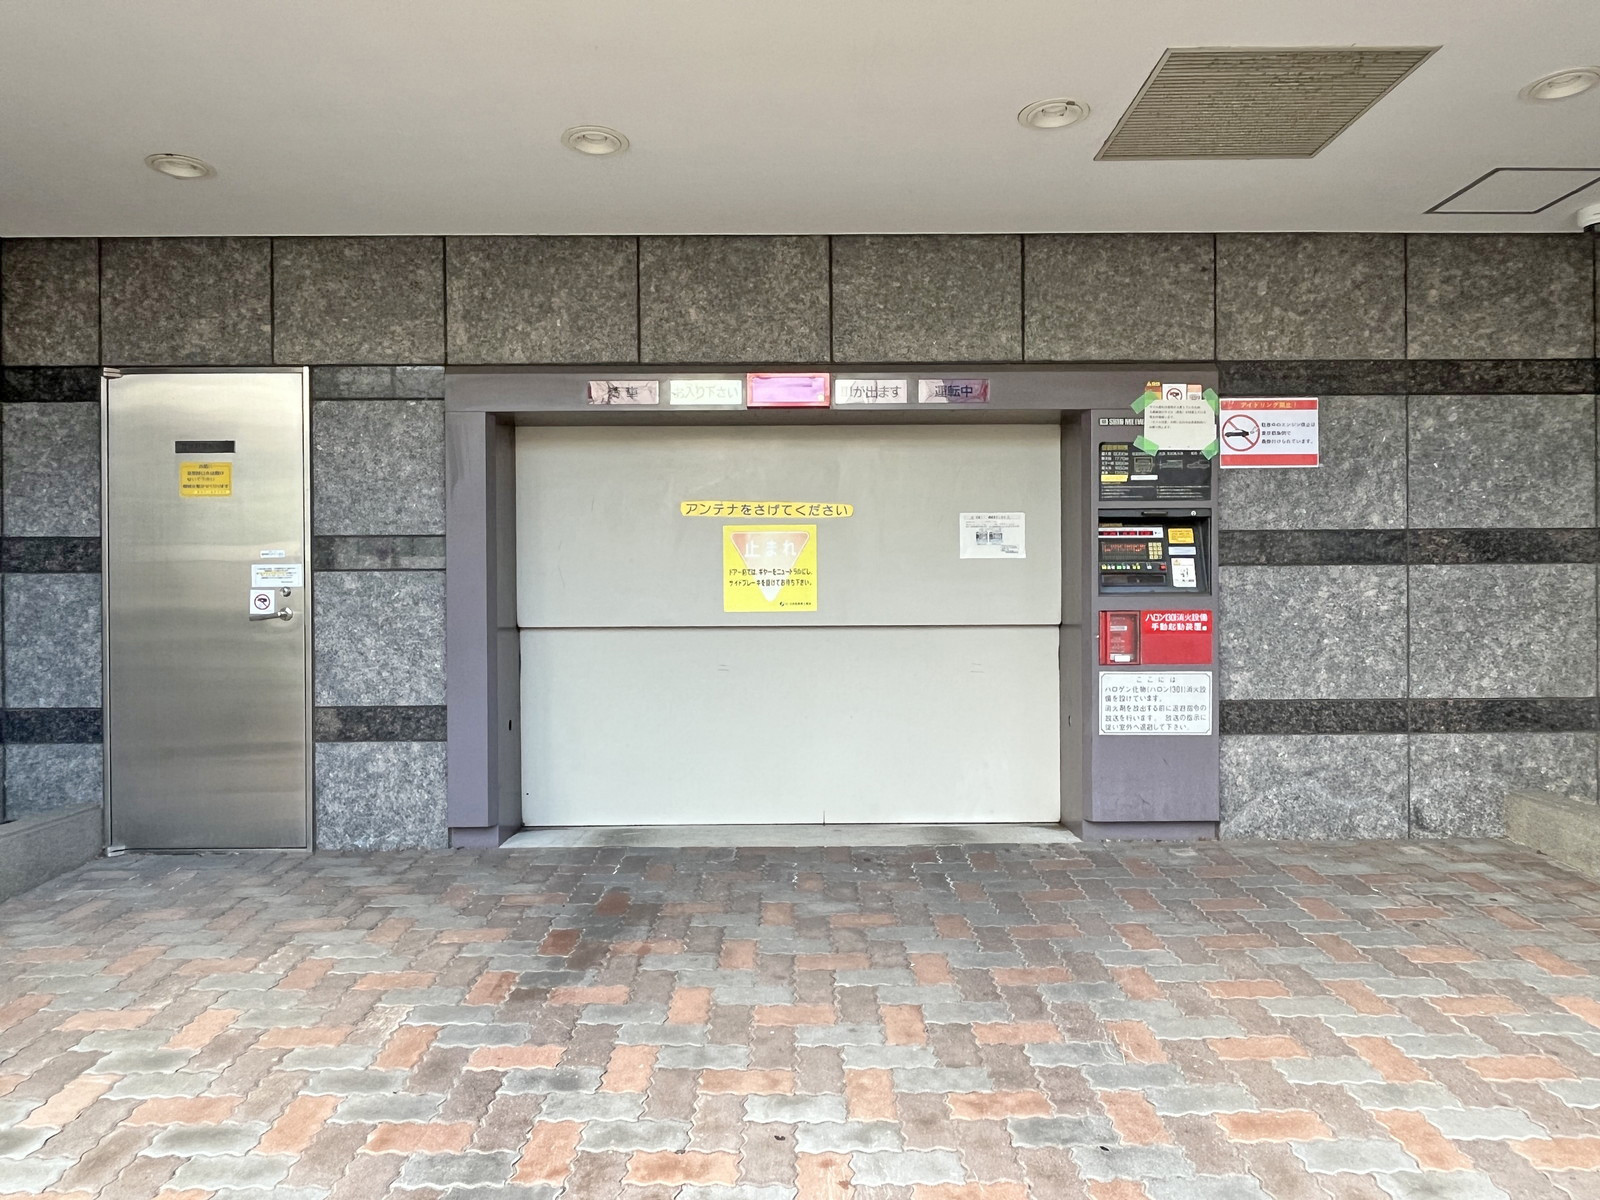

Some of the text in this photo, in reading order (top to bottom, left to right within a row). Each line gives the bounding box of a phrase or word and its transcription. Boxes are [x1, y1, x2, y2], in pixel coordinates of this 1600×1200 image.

[672, 386, 739, 399] お入り下さい
[934, 385, 973, 398] 運転中
[686, 502, 848, 516] アンテナをさげてください
[744, 540, 797, 558] 止まれ
